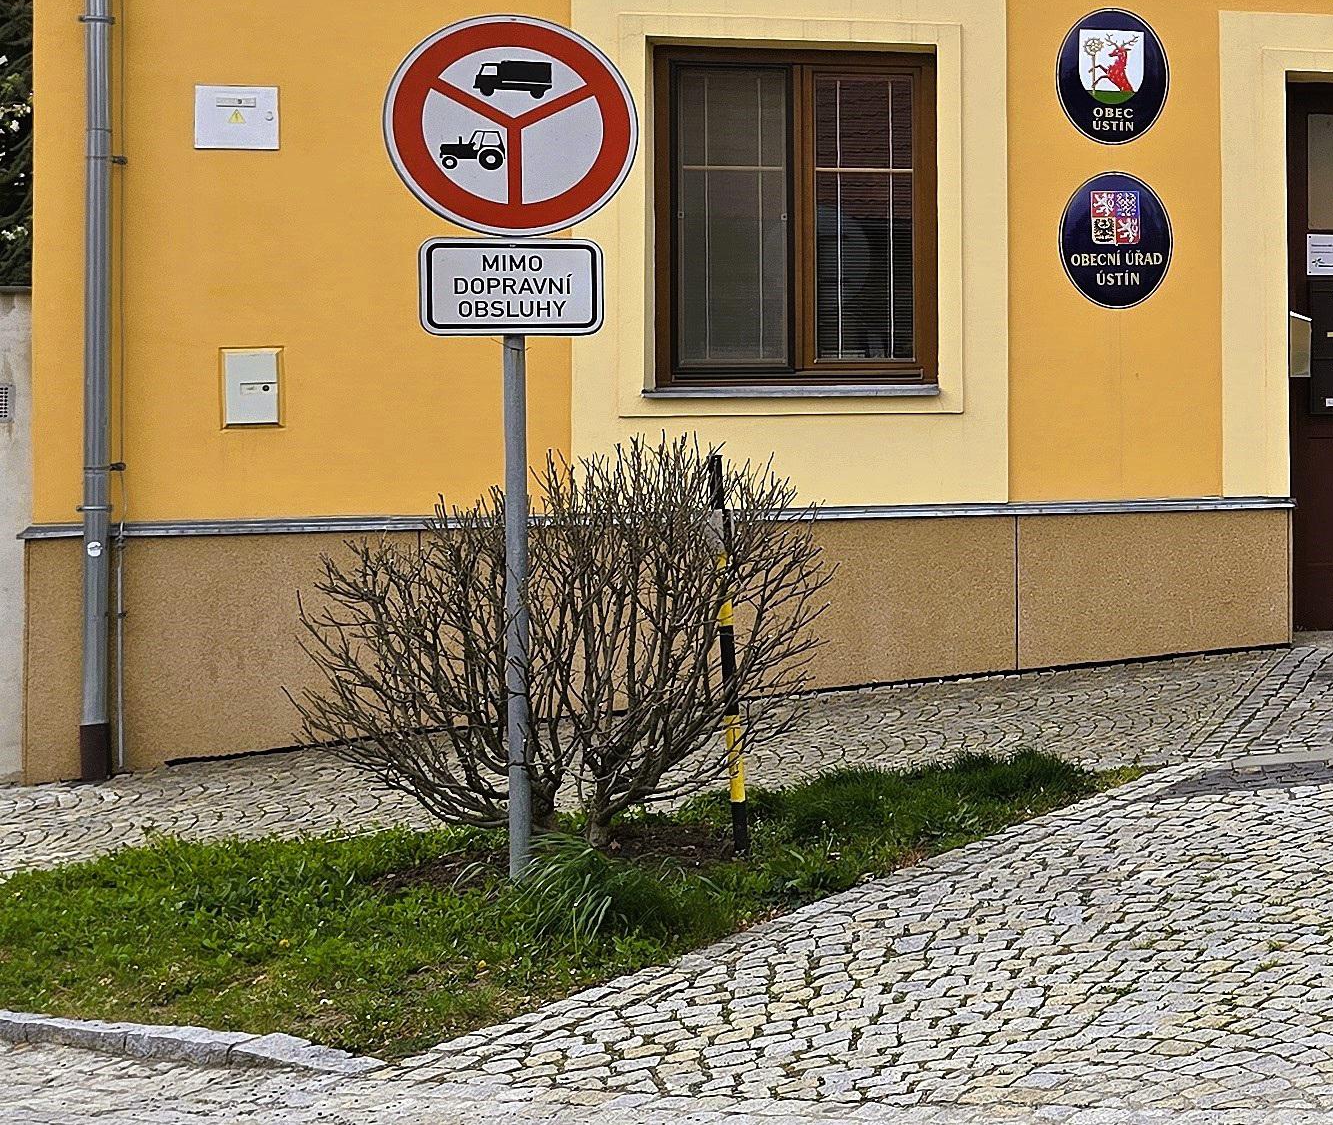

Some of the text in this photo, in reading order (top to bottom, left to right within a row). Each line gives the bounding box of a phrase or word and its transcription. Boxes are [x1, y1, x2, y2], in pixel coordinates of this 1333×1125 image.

[1092, 107, 1134, 119] OBEC
[1092, 117, 1134, 132] ÚSTÍN
[482, 254, 543, 272] MIMO
[1070, 249, 1163, 267] OBECNÍ ÚŘAD
[453, 273, 573, 295] DOPRAVNÍ
[1096, 269, 1140, 286] ÚSTÍN
[458, 300, 567, 318] OBSLUHY
